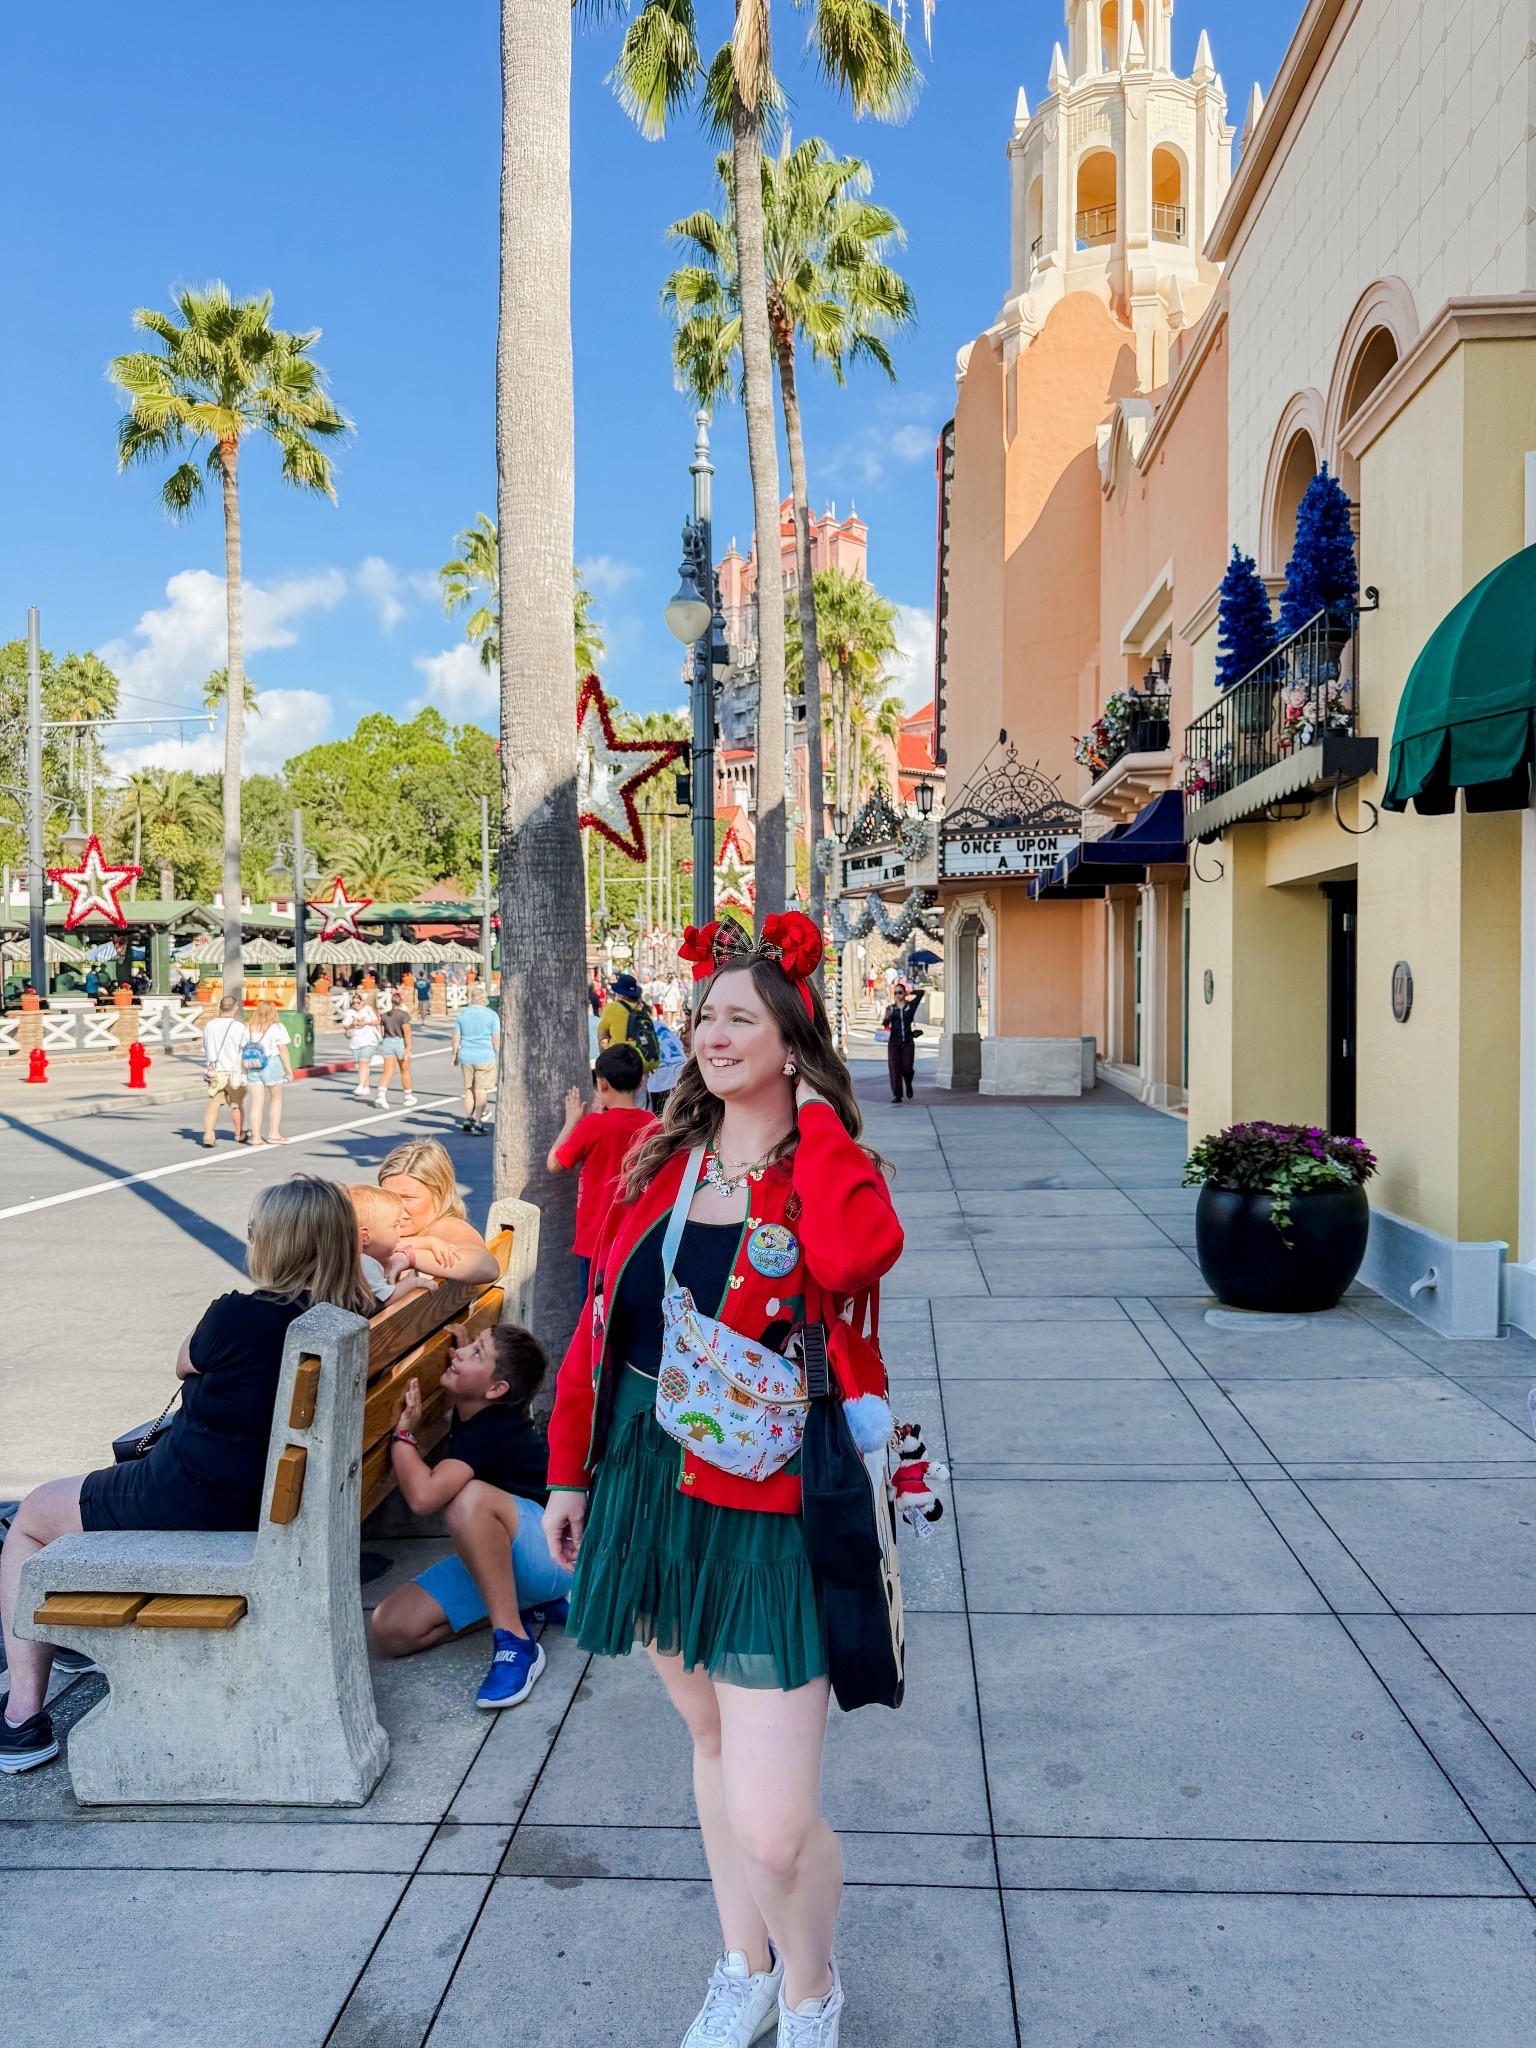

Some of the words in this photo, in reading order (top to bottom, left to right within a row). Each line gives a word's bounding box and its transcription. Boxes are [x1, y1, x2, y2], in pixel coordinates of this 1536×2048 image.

[961, 841, 1001, 854] ONCE
[1016, 838, 1057, 852] UPON
[998, 856, 1008, 868] A
[1023, 853, 1059, 867] TIME
[494, 1650, 517, 1662] NIKE
